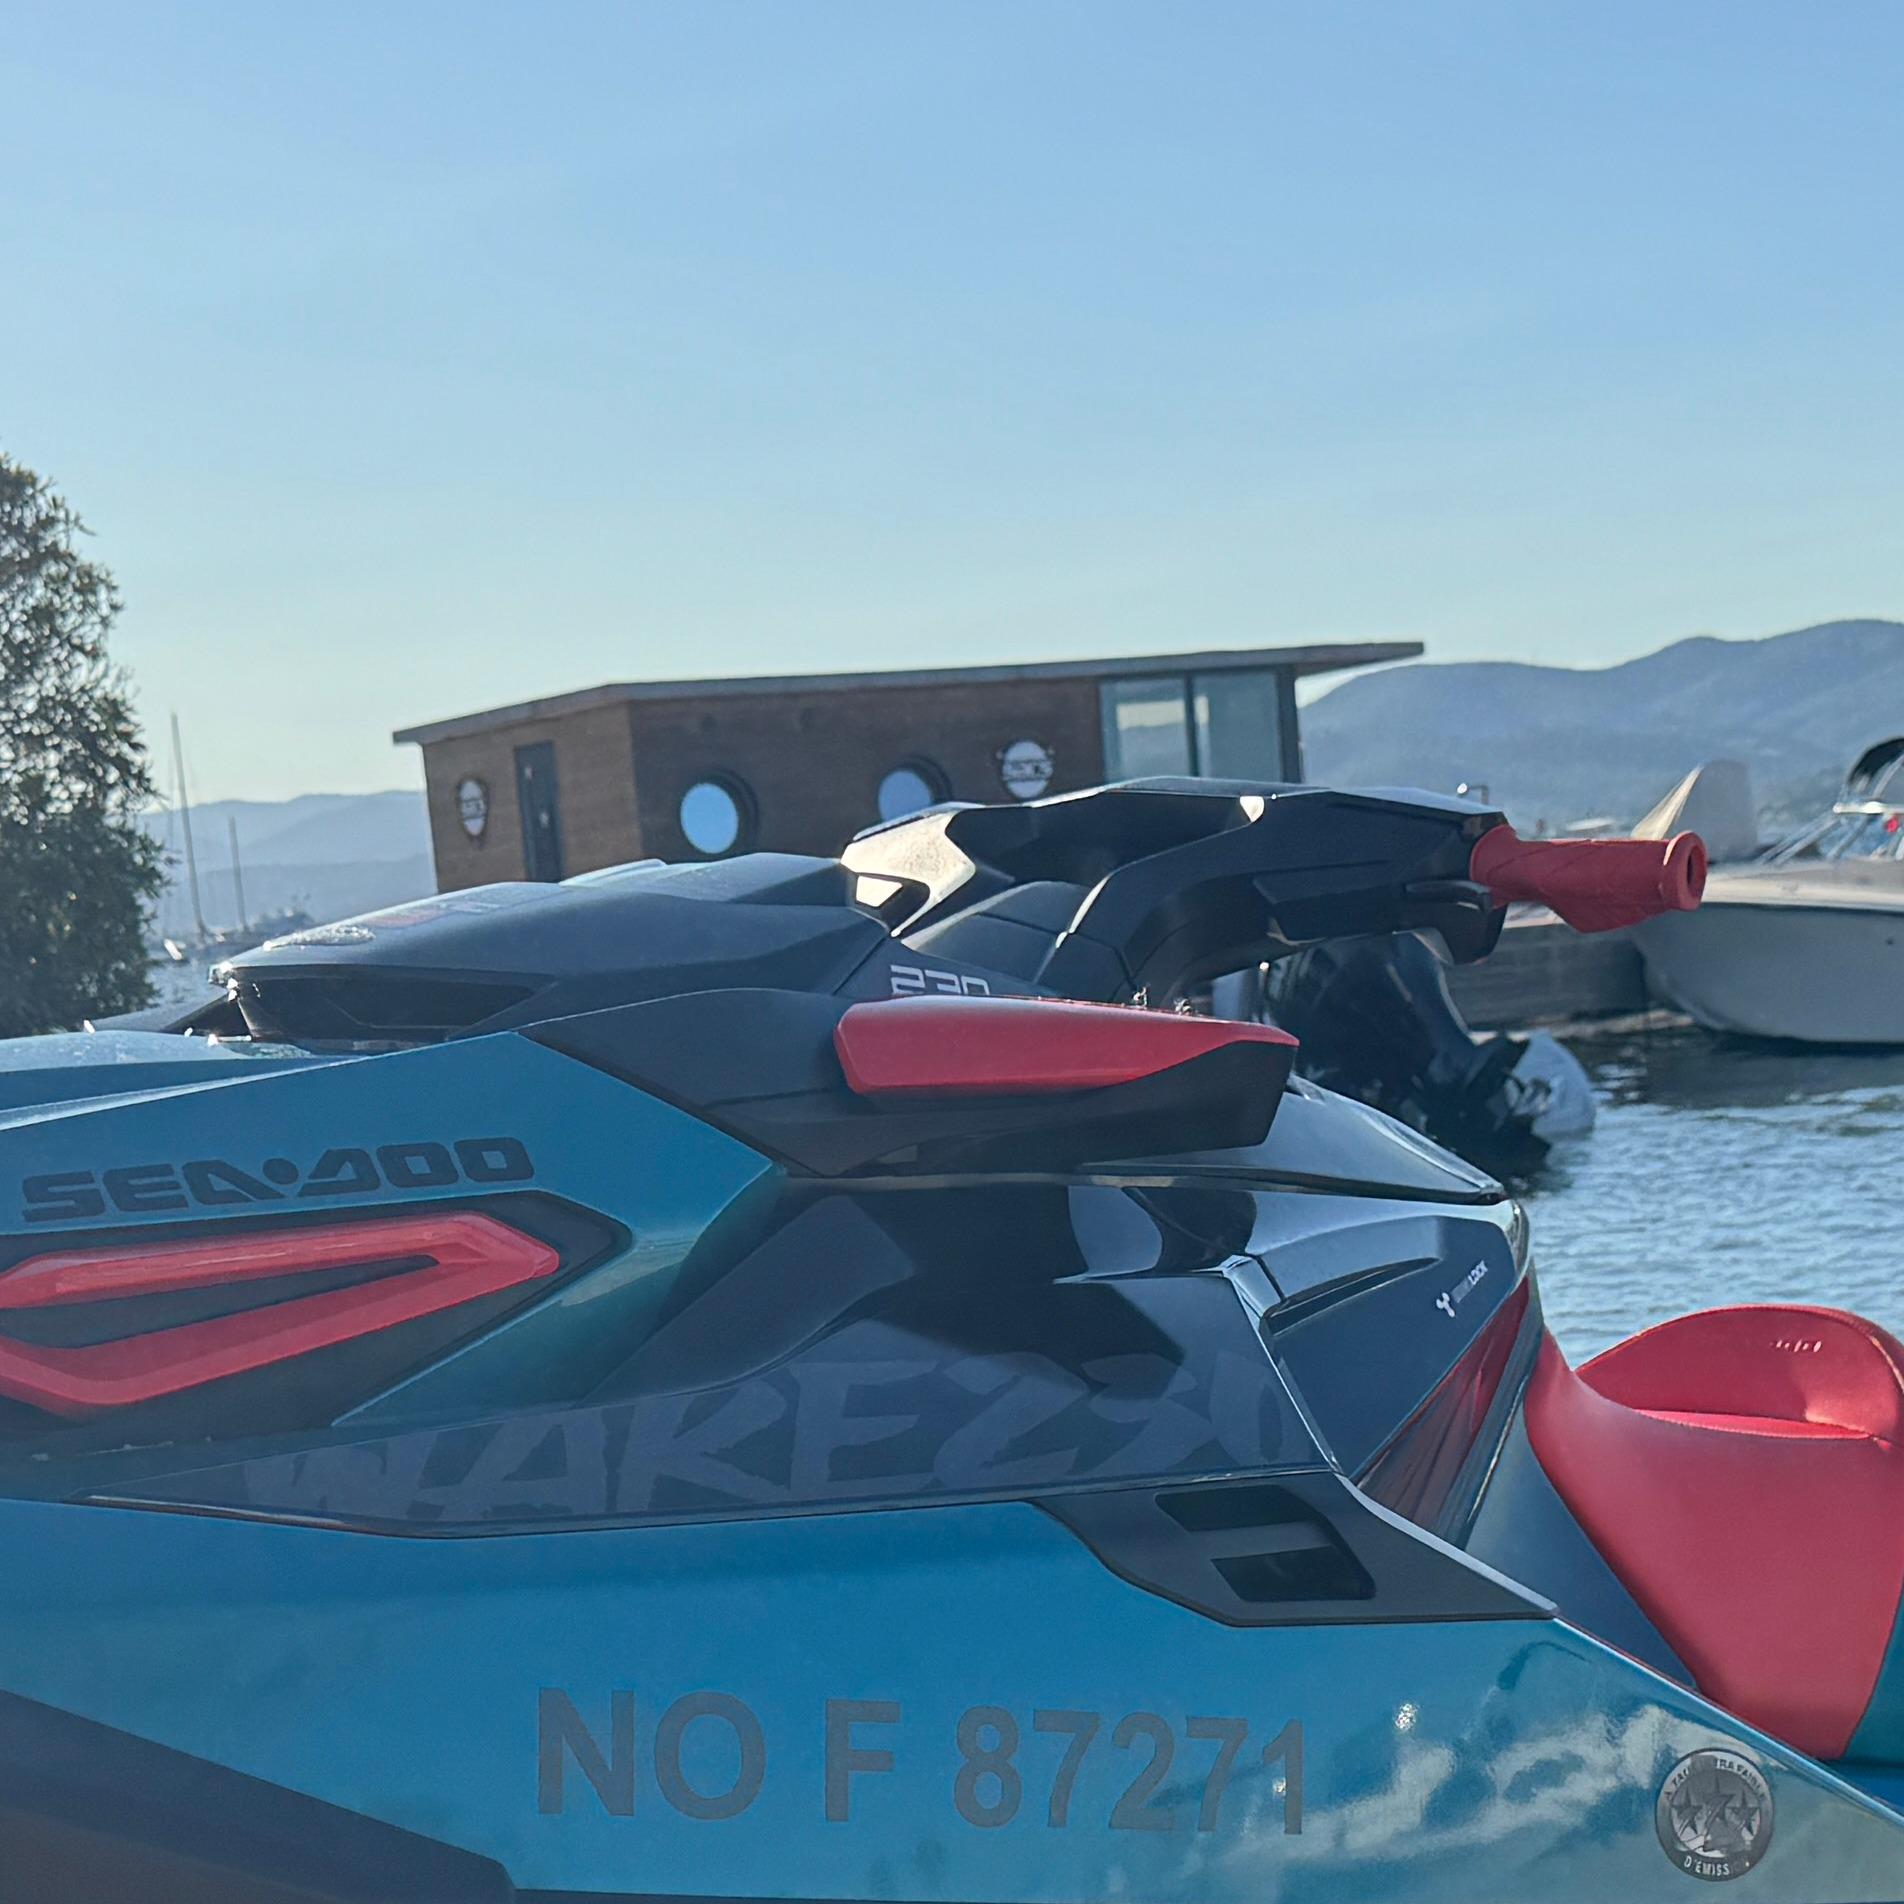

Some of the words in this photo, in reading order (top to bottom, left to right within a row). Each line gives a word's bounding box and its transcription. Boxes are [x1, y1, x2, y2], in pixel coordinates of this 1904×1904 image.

[537, 1686, 767, 1821] NO
[824, 1698, 901, 1822] F
[953, 1704, 1304, 1836] 87271
